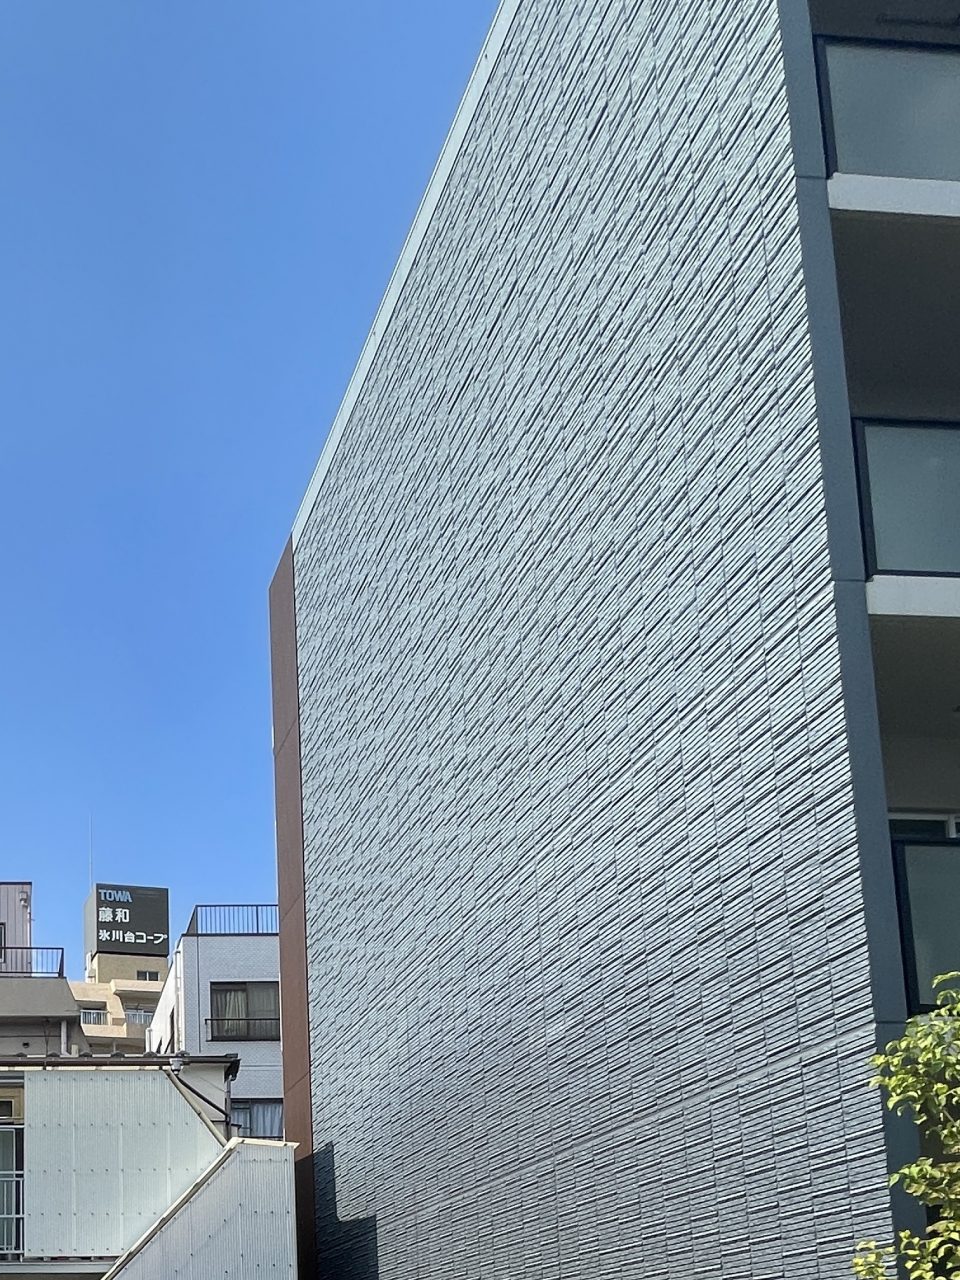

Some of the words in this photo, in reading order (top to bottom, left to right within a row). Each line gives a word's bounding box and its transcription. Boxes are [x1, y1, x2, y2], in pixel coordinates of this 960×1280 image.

[99, 889, 132, 902] TOWA
[99, 907, 130, 923] 藤和
[99, 930, 168, 944] 氷川台コープ
